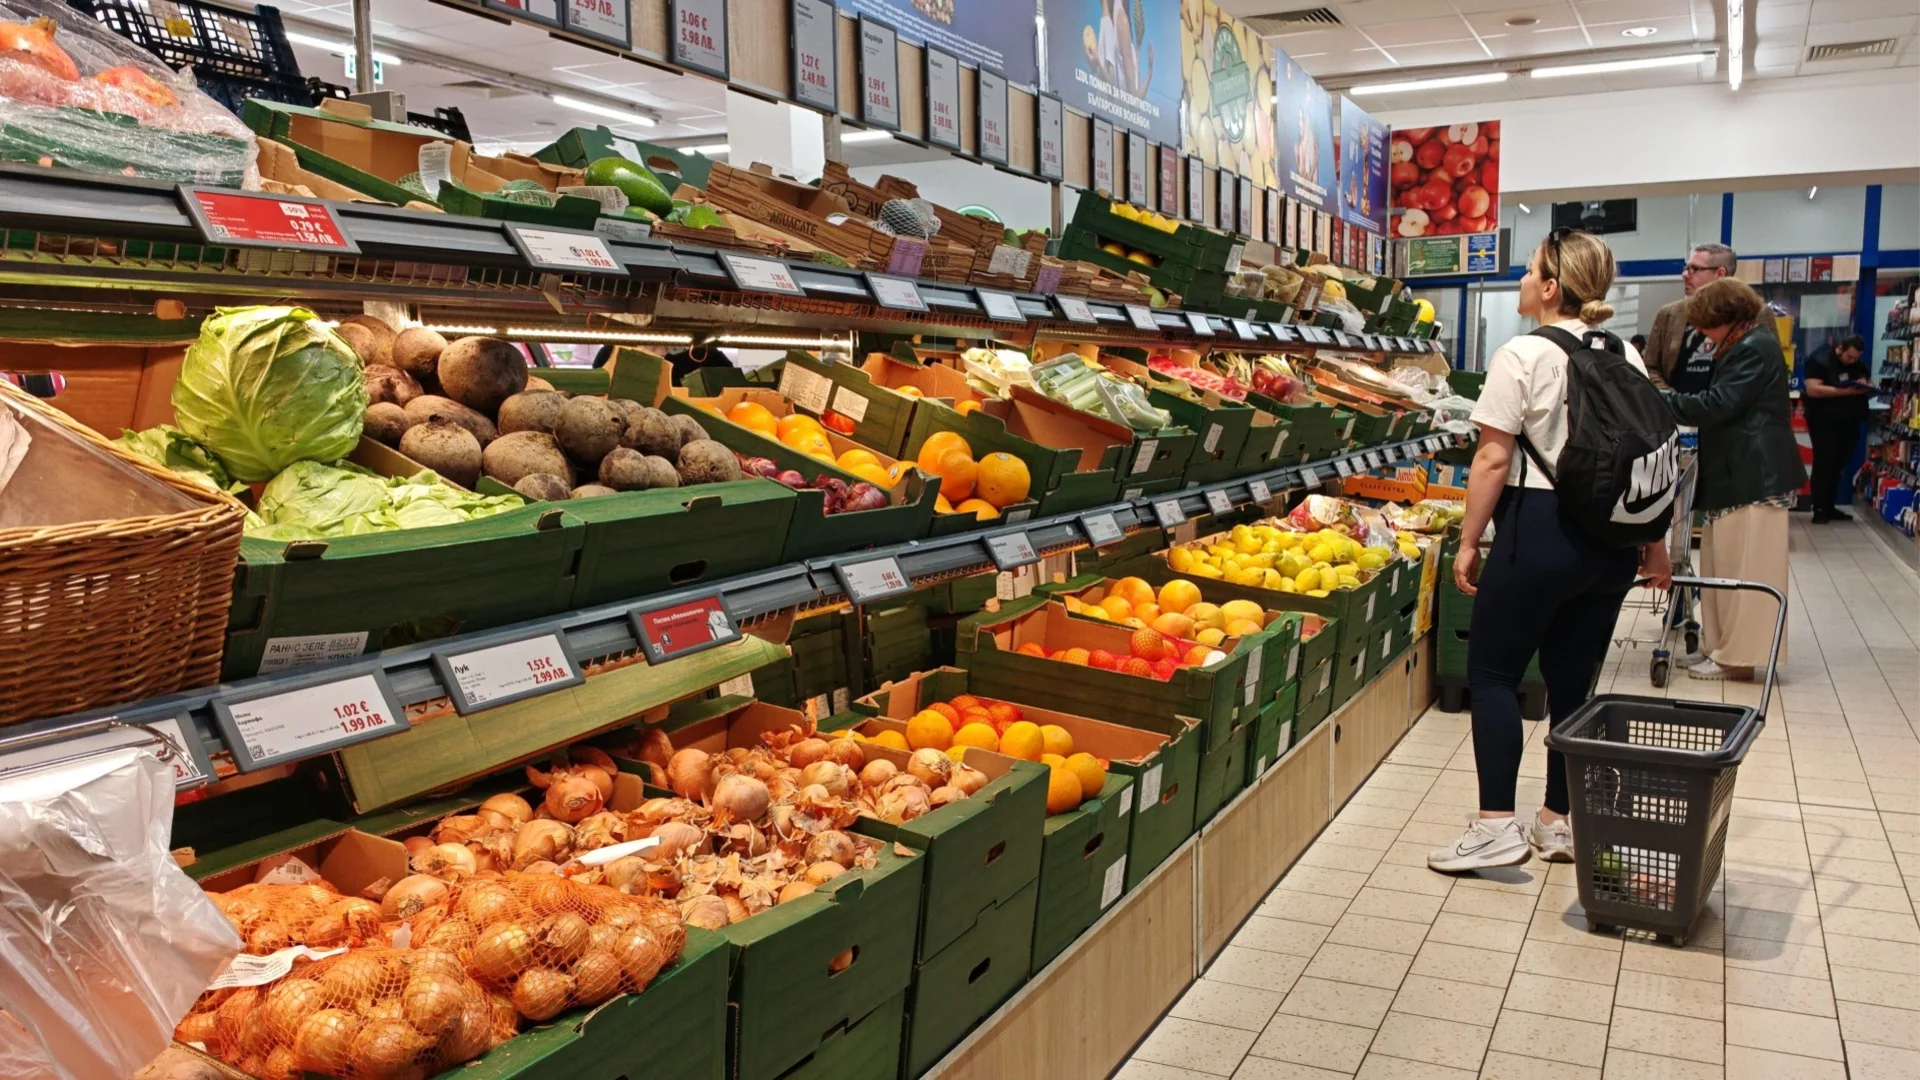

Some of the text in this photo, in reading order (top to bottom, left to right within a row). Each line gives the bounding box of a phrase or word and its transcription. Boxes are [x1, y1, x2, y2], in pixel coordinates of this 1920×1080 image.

[681, 10, 708, 31] 3.06 €
[682, 30, 715, 51] 5.98 ЛВ.
[801, 53, 813, 67] 1.27
[290, 219, 324, 233] 0.79 €
[769, 211, 818, 237] AGUACATE
[298, 231, 317, 243] 1.55
[318, 234, 338, 244] ЛВ.
[580, 248, 594, 256] 1.02
[586, 258, 601, 266] 1.99
[1626, 428, 1679, 504] NIKE
[1396, 470, 1416, 483] Jumbo
[270, 641, 301, 653] РАННО
[454, 664, 470, 674] Лук
[526, 656, 553, 672] 1.53 €
[533, 670, 553, 685] 2.99
[553, 667, 569, 680] ЛВ.
[333, 700, 369, 719] 1.02 €
[340, 718, 367, 734] 1.99
[367, 713, 387, 728] ЛВ.
